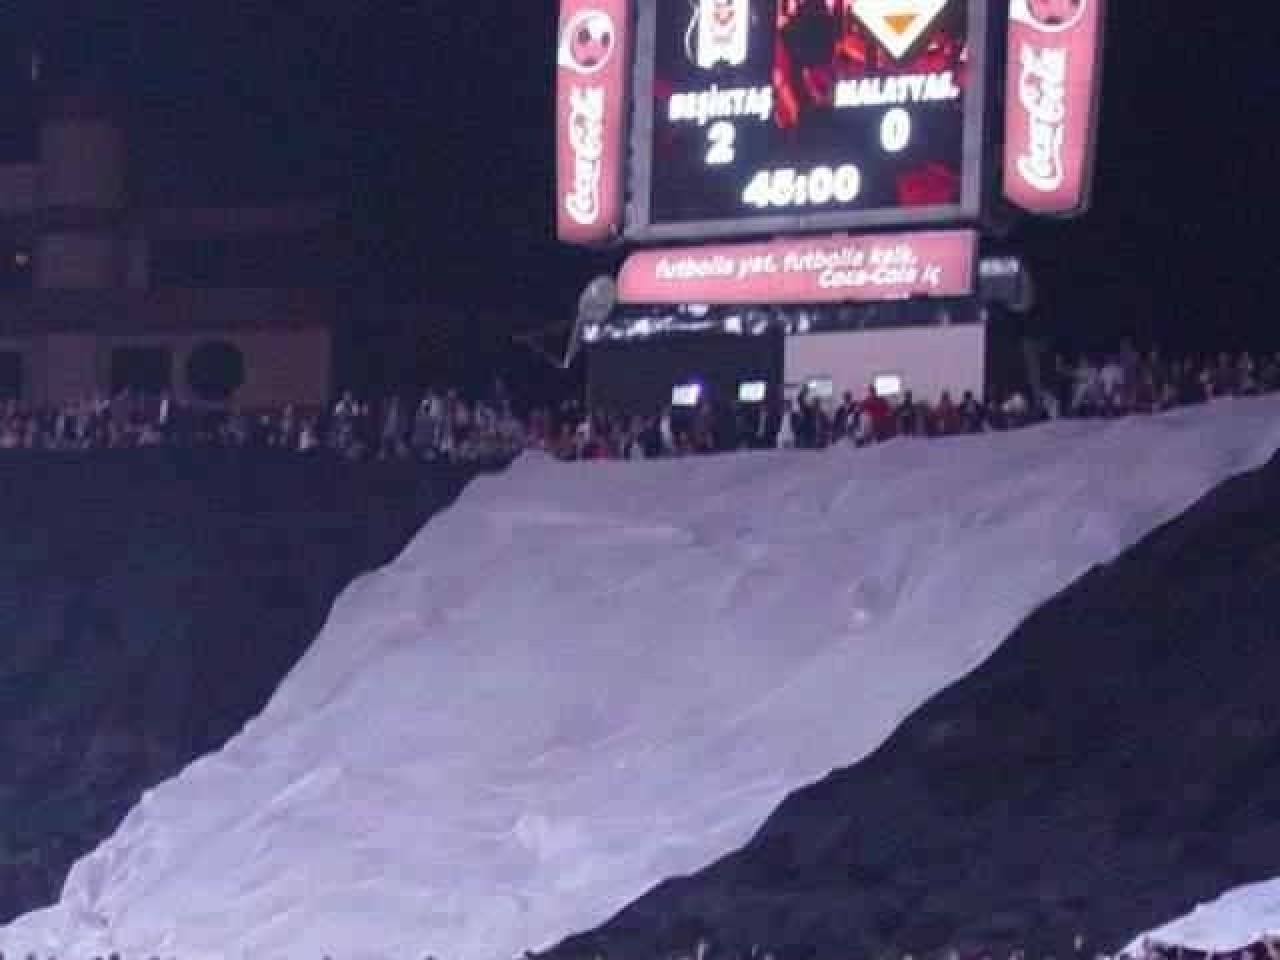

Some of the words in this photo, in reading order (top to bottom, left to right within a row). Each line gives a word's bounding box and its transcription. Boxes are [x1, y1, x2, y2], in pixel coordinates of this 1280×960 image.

[705, 120, 736, 164] 2
[880, 108, 911, 152] 0
[743, 164, 860, 207] 45:00
